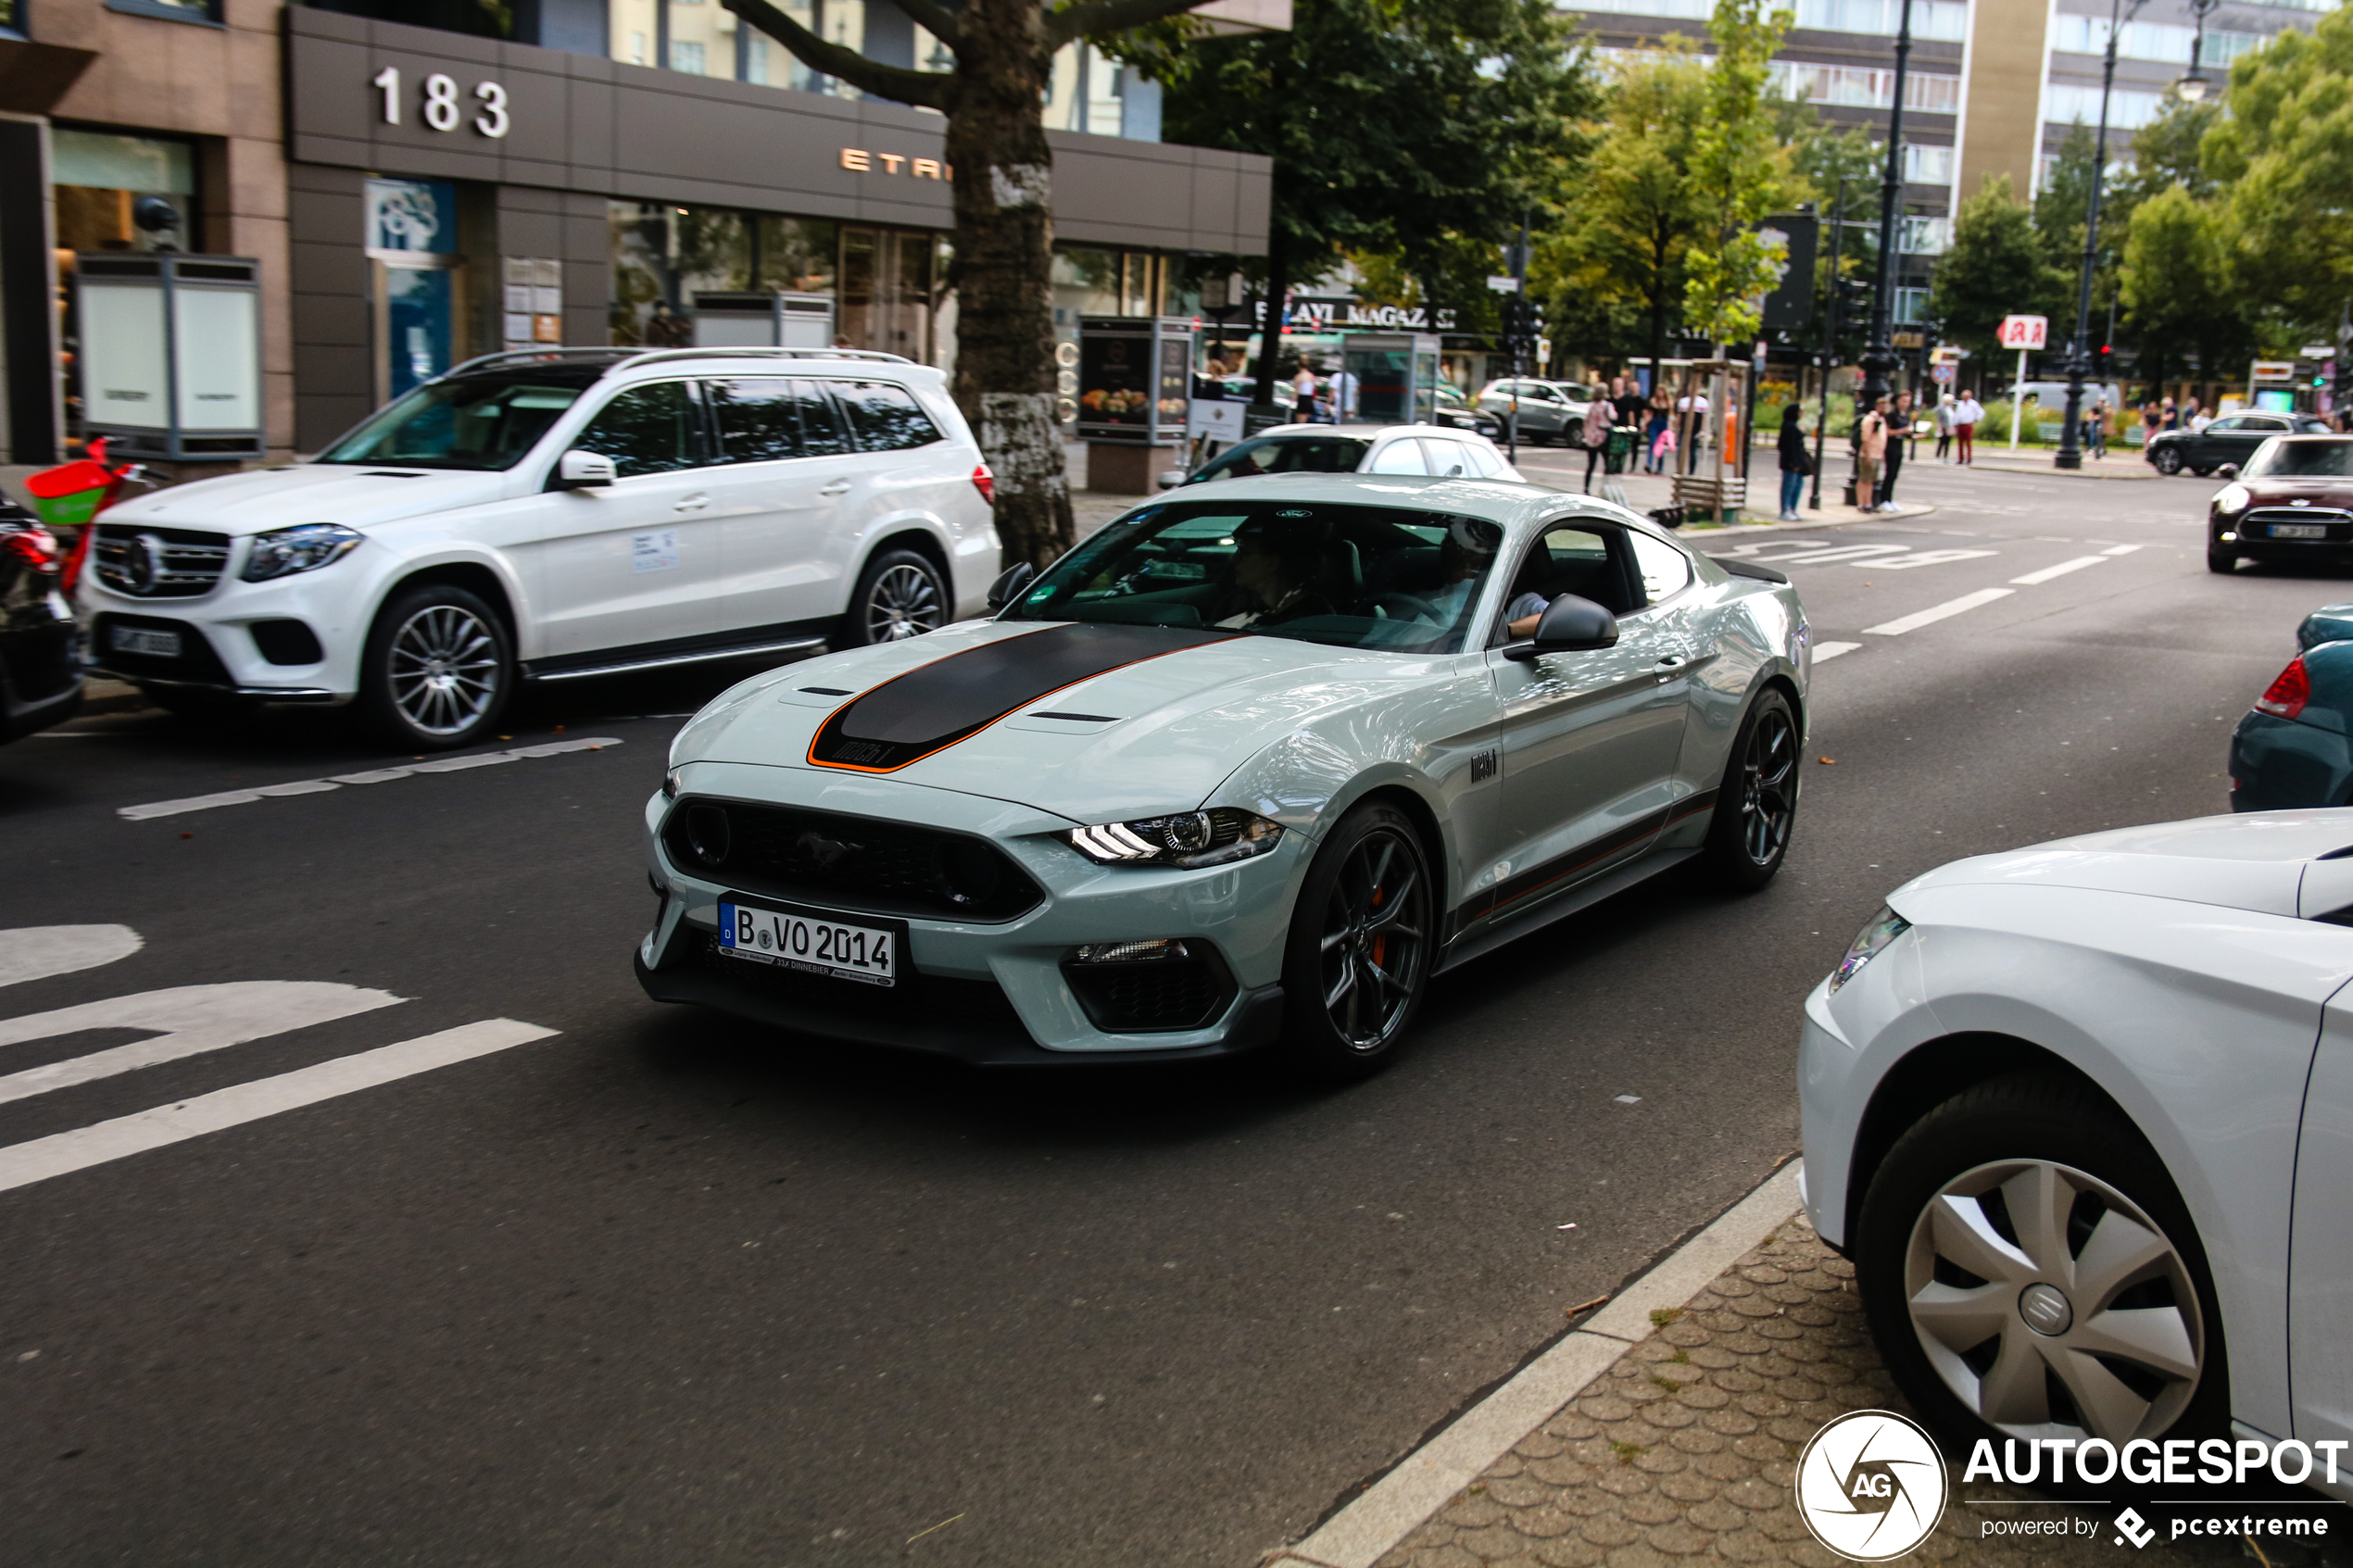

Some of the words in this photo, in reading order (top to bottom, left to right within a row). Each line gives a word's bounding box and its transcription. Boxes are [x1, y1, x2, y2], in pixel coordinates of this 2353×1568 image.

[373, 66, 510, 138] 183
[839, 147, 953, 183] ETR
[724, 929, 731, 939] D
[737, 909, 755, 944] B
[774, 916, 809, 955] VO
[816, 924, 888, 970] 2014
[791, 962, 829, 975] DINNEBIER
